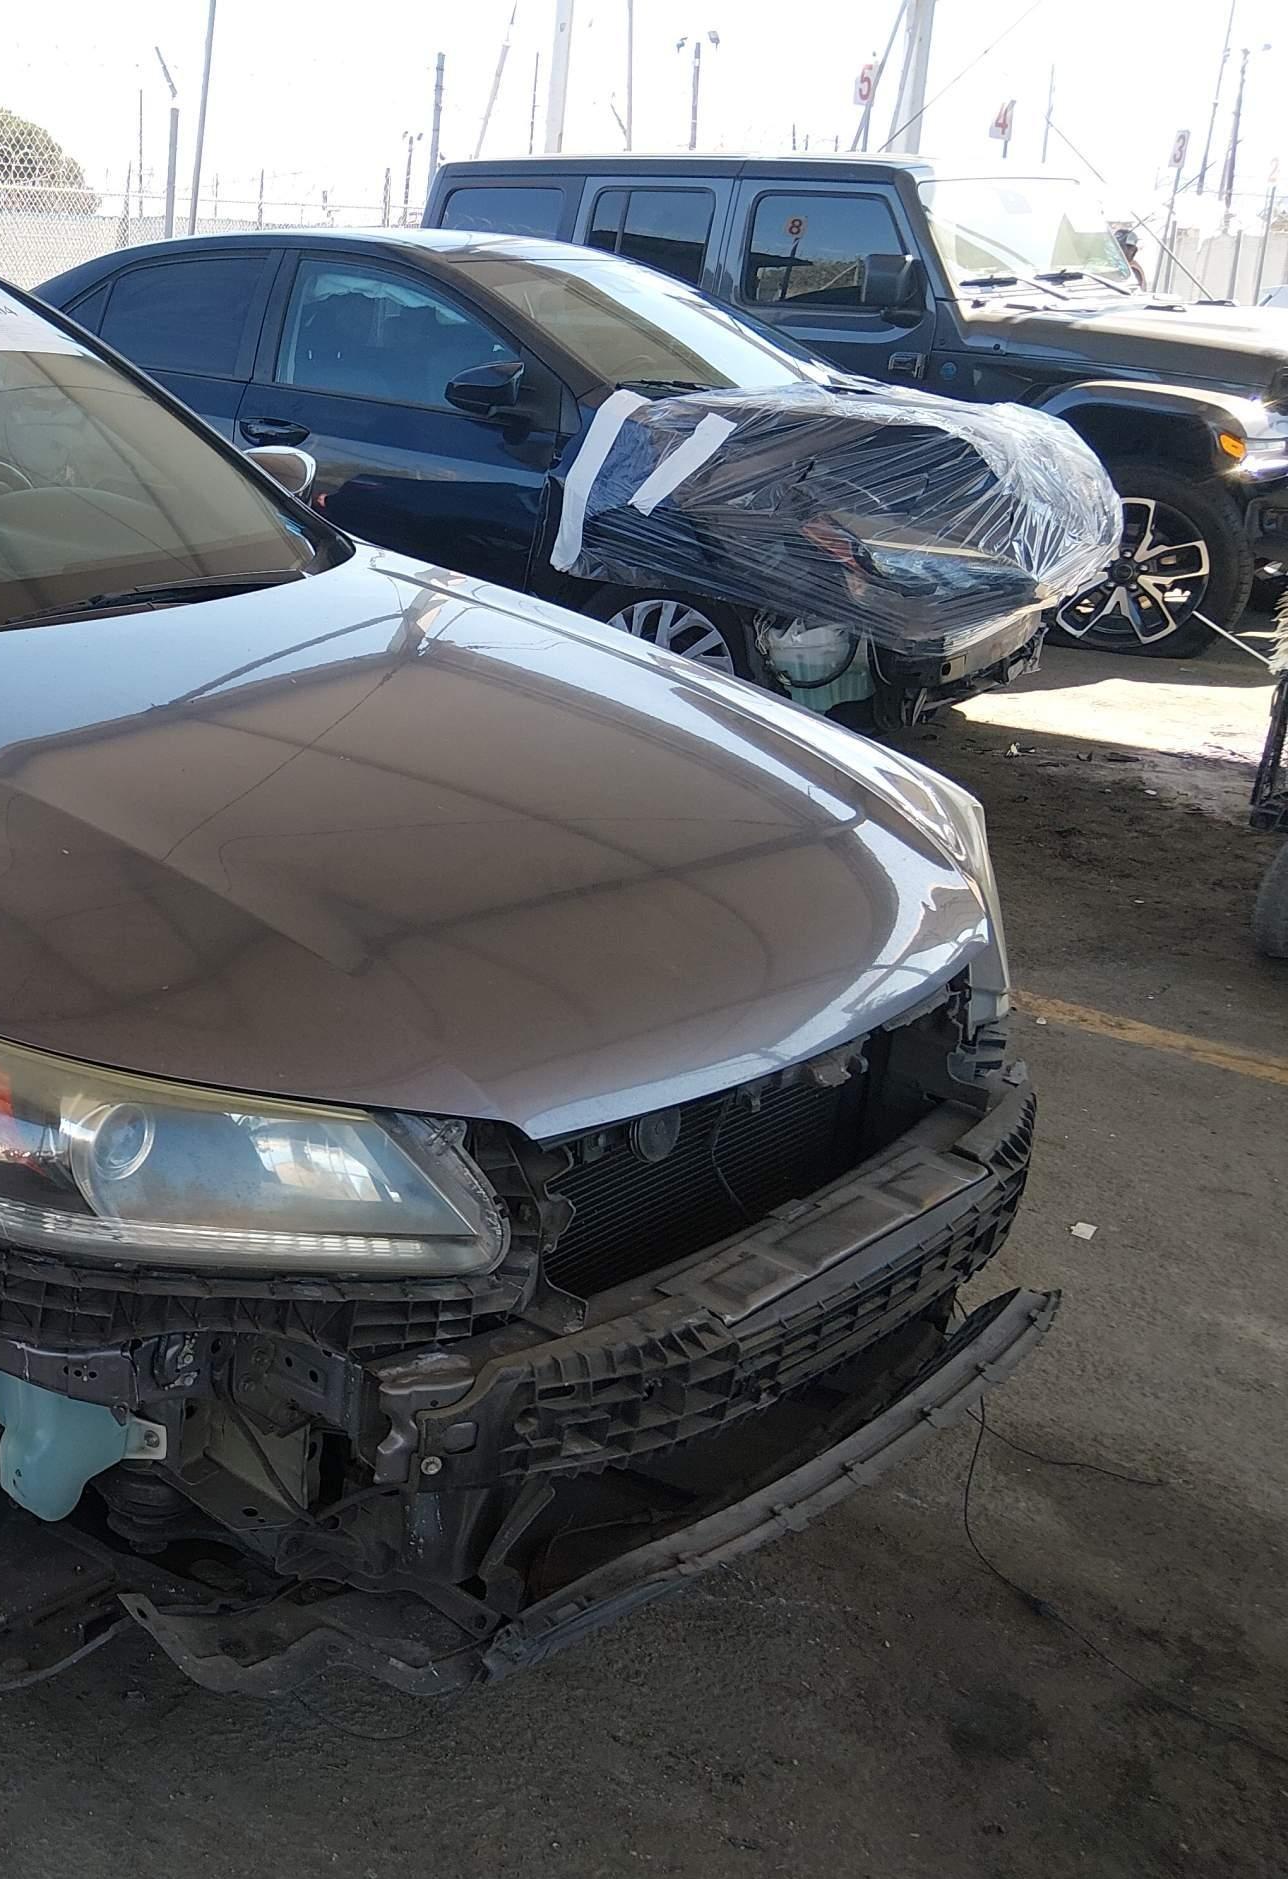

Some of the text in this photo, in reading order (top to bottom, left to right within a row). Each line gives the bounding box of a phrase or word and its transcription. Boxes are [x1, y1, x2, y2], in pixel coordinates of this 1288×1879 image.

[859, 63, 873, 101] 5
[995, 102, 1009, 135] 4
[1173, 134, 1186, 163] 3
